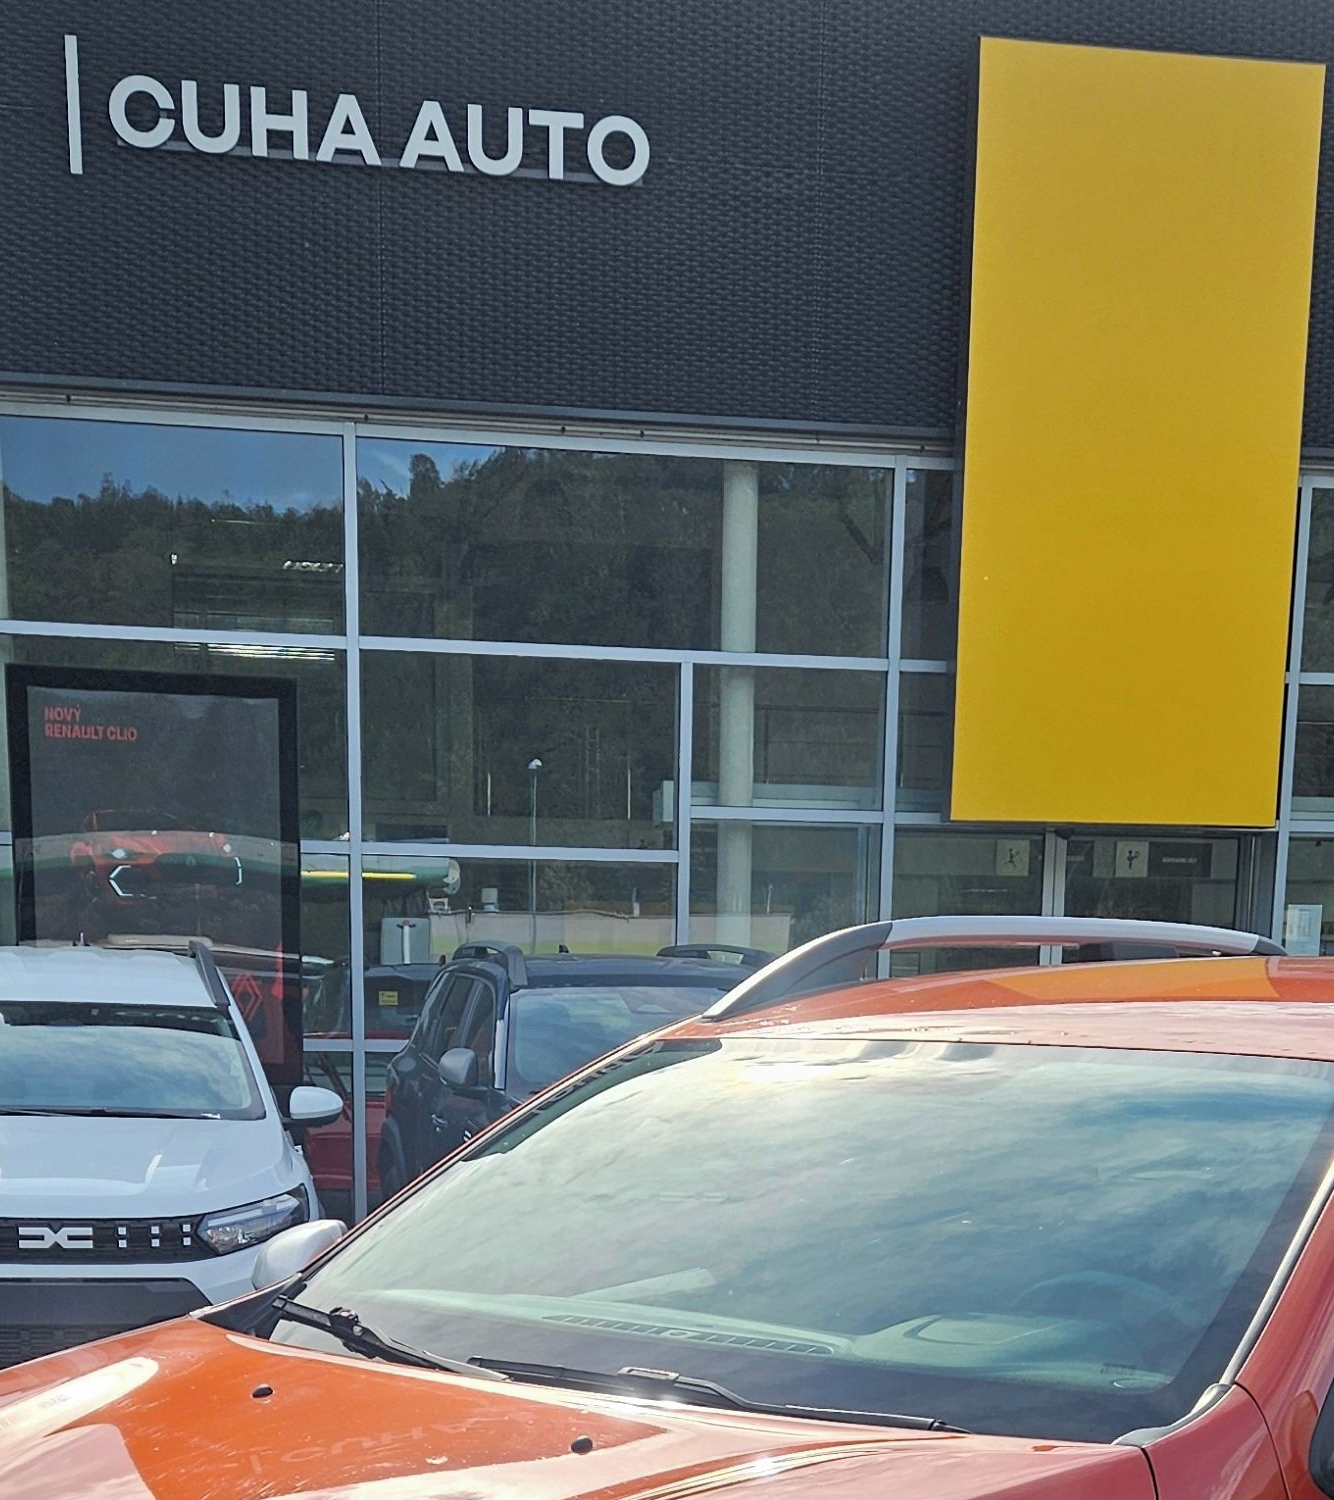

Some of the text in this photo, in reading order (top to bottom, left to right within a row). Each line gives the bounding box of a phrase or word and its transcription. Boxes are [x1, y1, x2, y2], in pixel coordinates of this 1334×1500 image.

[109, 75, 650, 186] CUHA AUTO
[44, 704, 81, 722] NOVÝ
[45, 723, 138, 740] RENAULT CLIO
